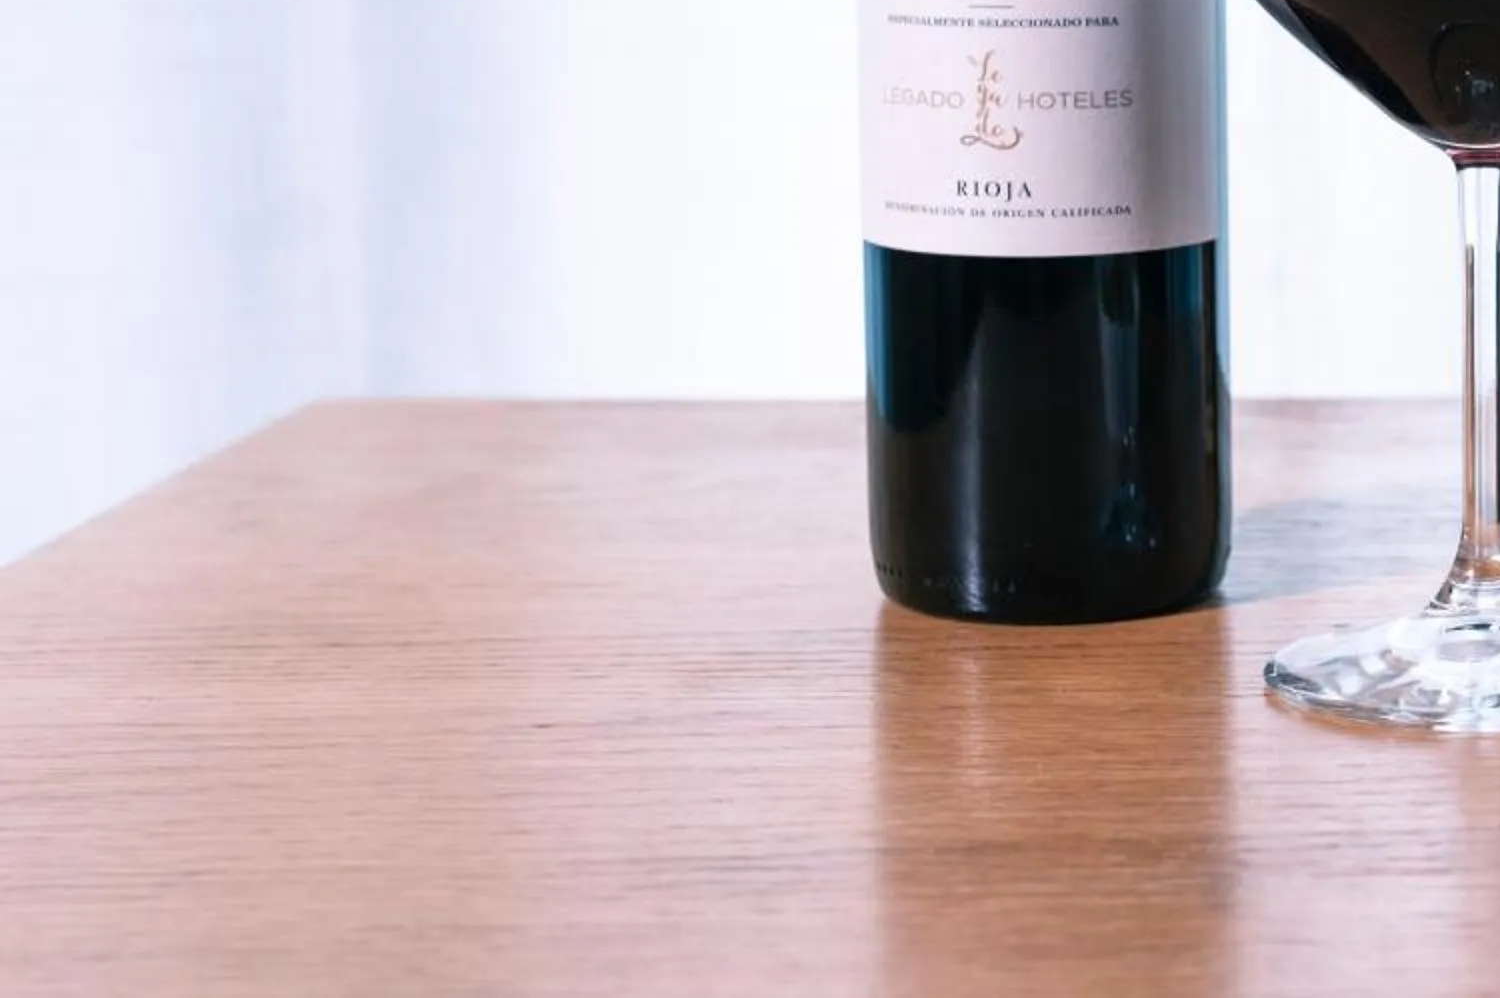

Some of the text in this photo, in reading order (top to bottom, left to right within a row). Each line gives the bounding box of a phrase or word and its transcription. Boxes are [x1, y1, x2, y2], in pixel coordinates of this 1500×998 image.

[977, 16, 1082, 29] SELECCIONADO
[1085, 15, 1120, 28] PARA
[883, 87, 965, 110] LEGADO
[1017, 89, 1135, 111] HOTELES
[956, 179, 1033, 202] RIOJA
[970, 208, 986, 218] DE
[991, 208, 1045, 219] ORIGEN
[1051, 205, 1132, 219] CALIFICADA
